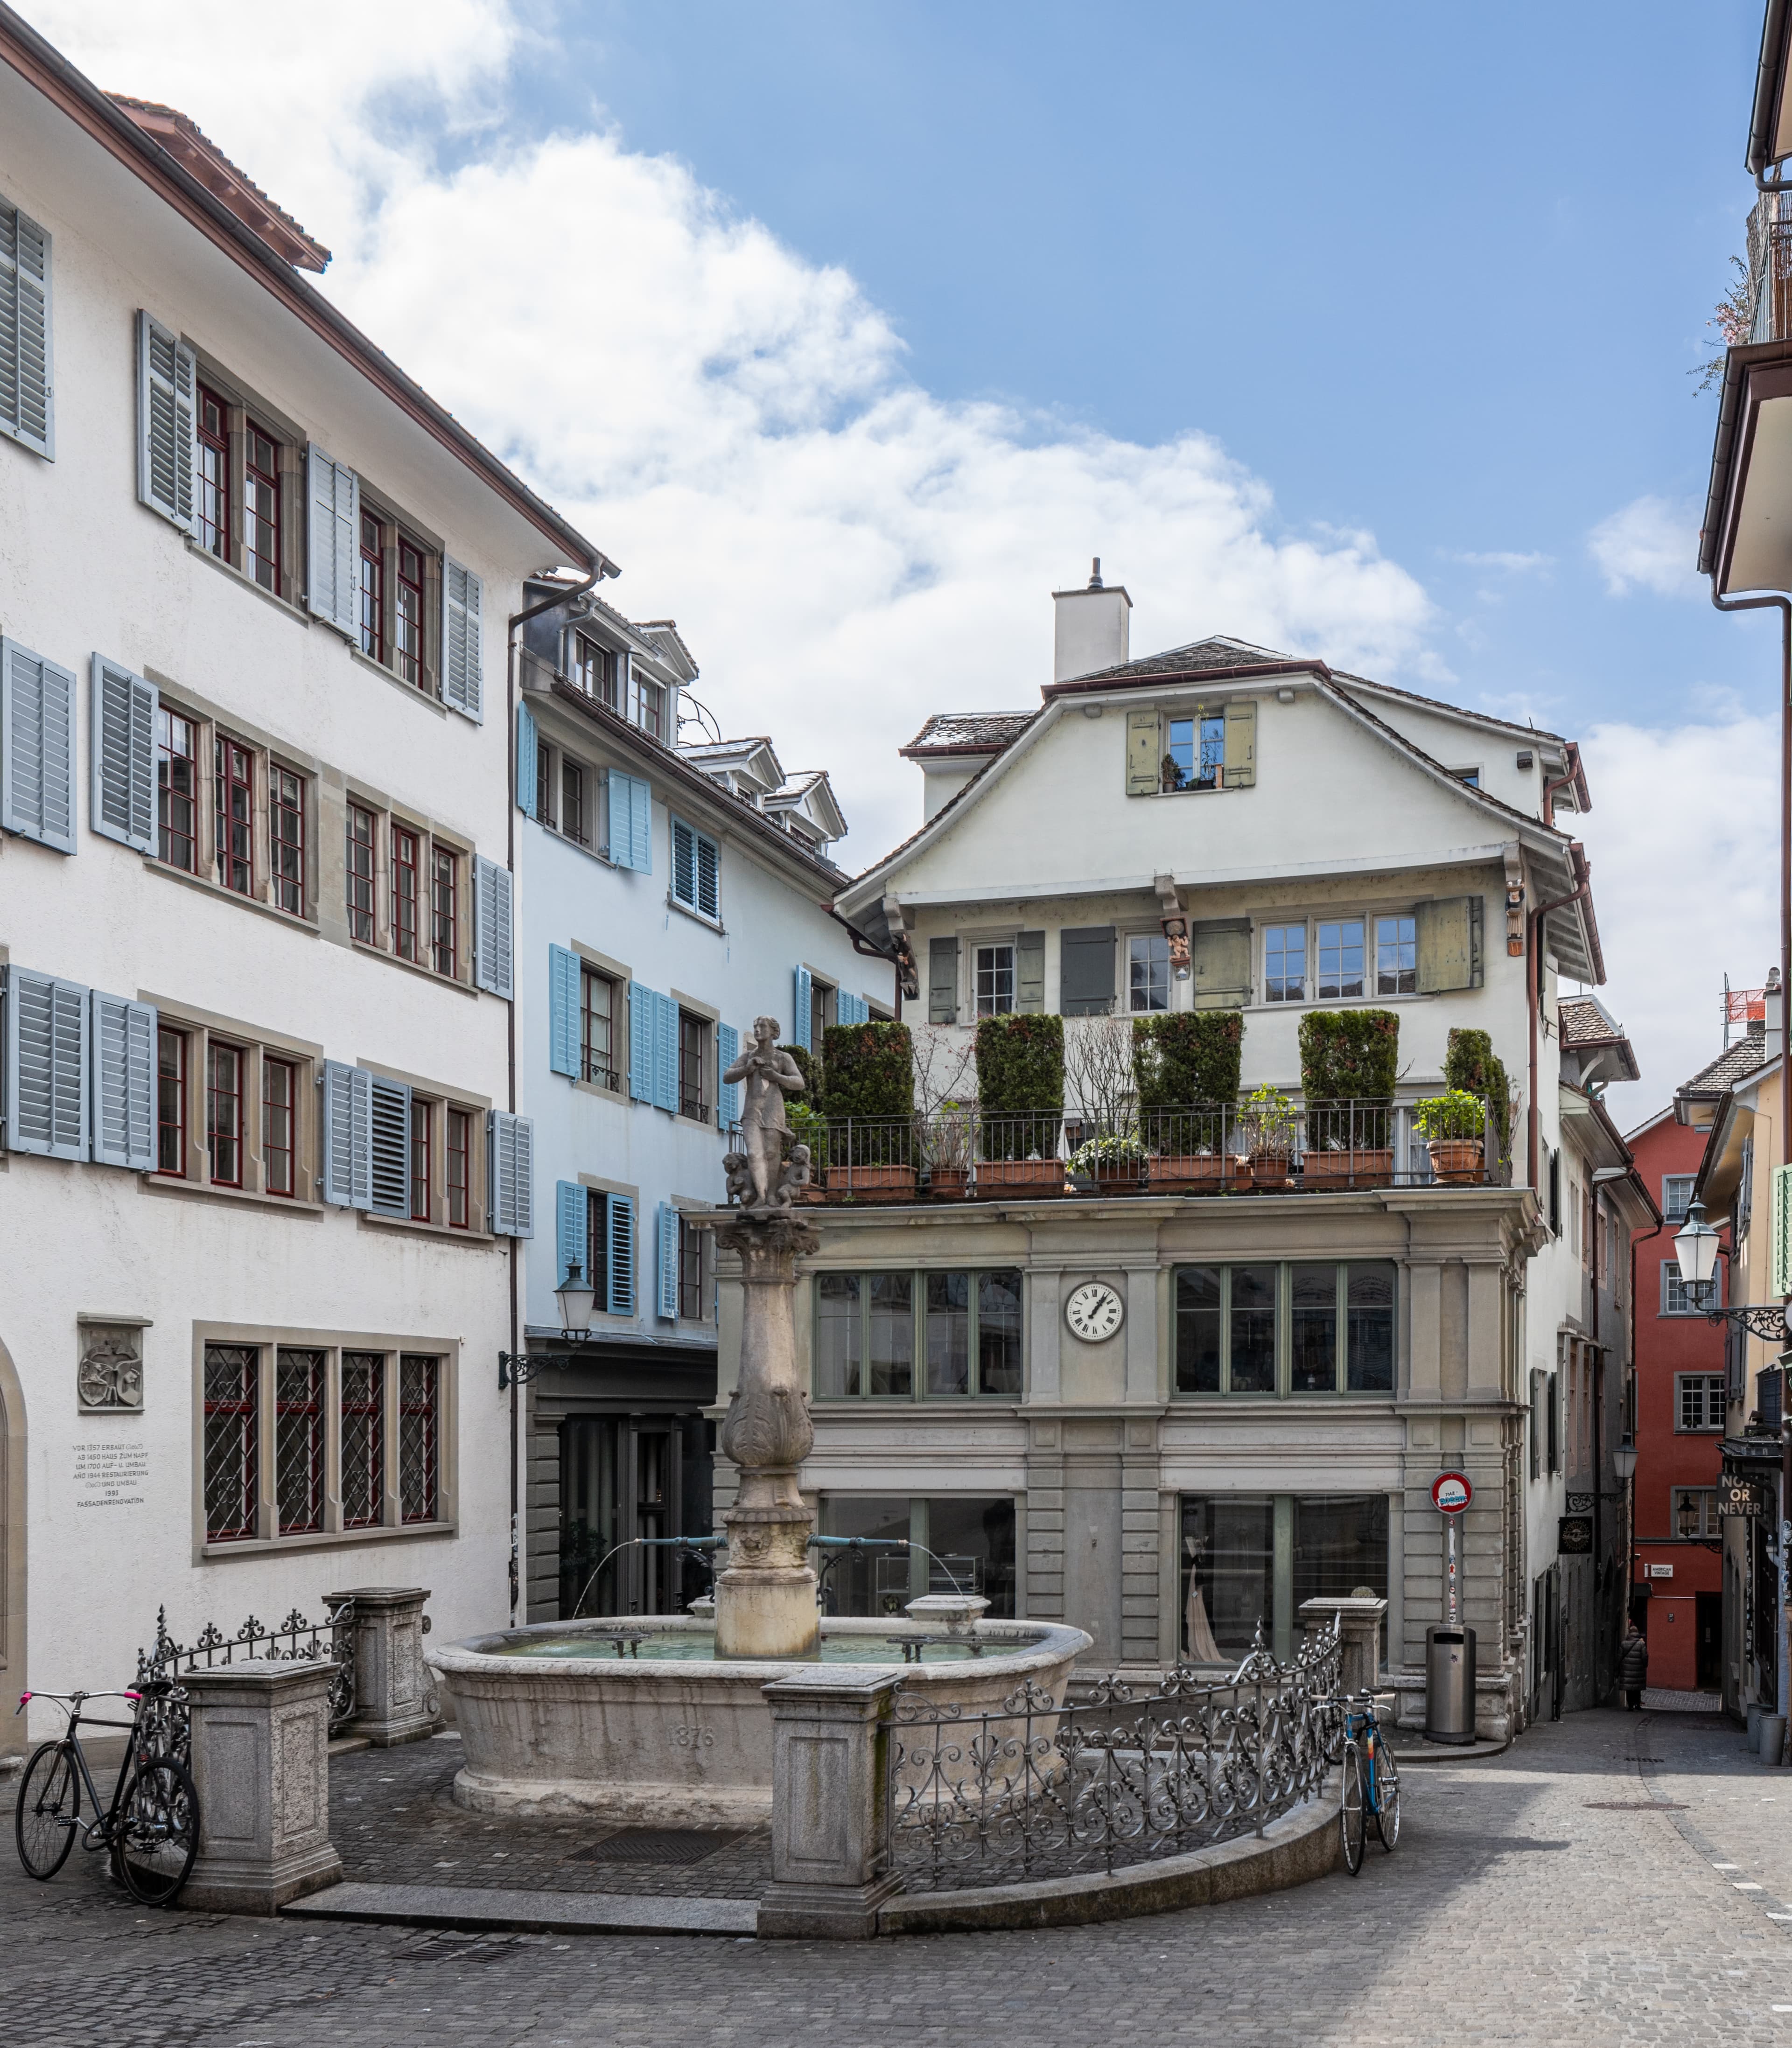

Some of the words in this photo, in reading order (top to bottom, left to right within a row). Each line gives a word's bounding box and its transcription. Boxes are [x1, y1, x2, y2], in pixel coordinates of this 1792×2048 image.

[1730, 1489, 1750, 1501] OR
[77, 1498, 144, 1507] FASSADENRENOVATION
[1718, 1502, 1761, 1515] NEVER
[667, 1726, 714, 1747] 1876
